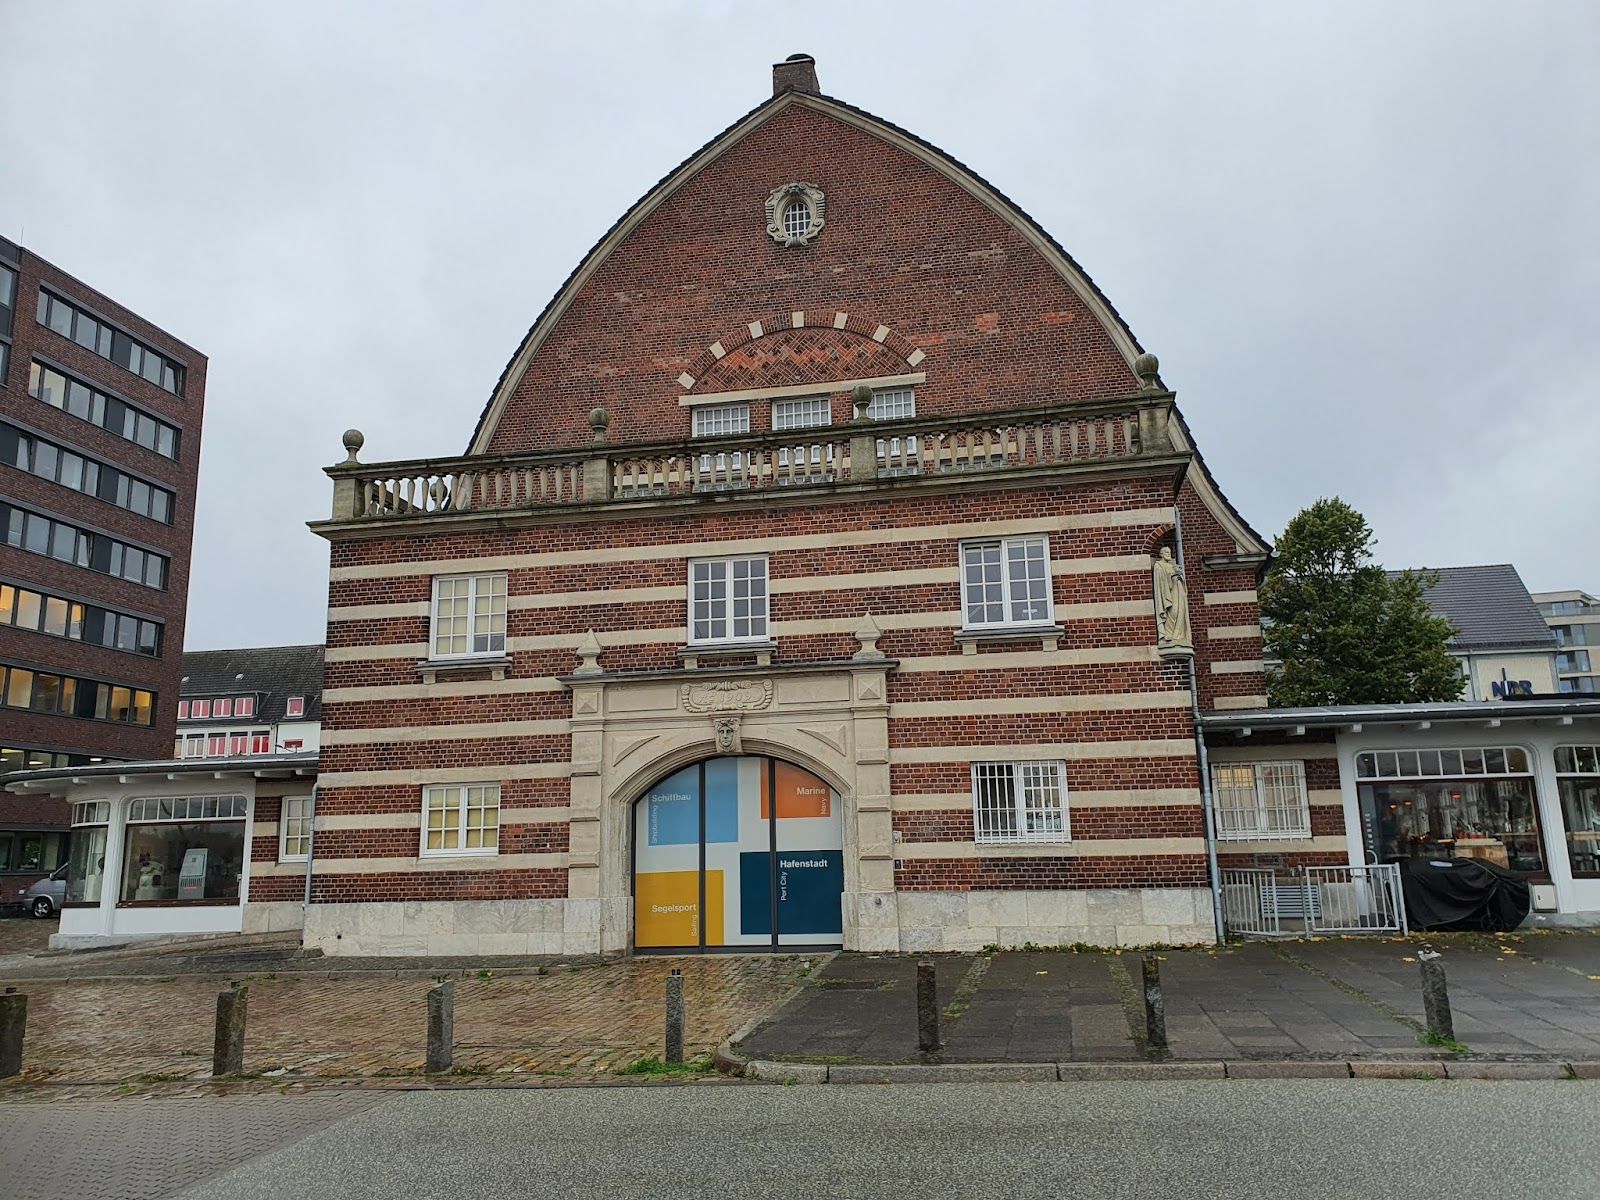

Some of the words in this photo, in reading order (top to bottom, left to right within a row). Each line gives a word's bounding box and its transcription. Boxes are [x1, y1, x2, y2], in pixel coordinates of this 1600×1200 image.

[1491, 680, 1533, 698] NDR
[797, 787, 826, 796] Marine
[651, 793, 691, 802] Schiffbau
[779, 858, 828, 868] Hafenstadt
[780, 871, 788, 886] City
[651, 904, 697, 914] Segelsport
